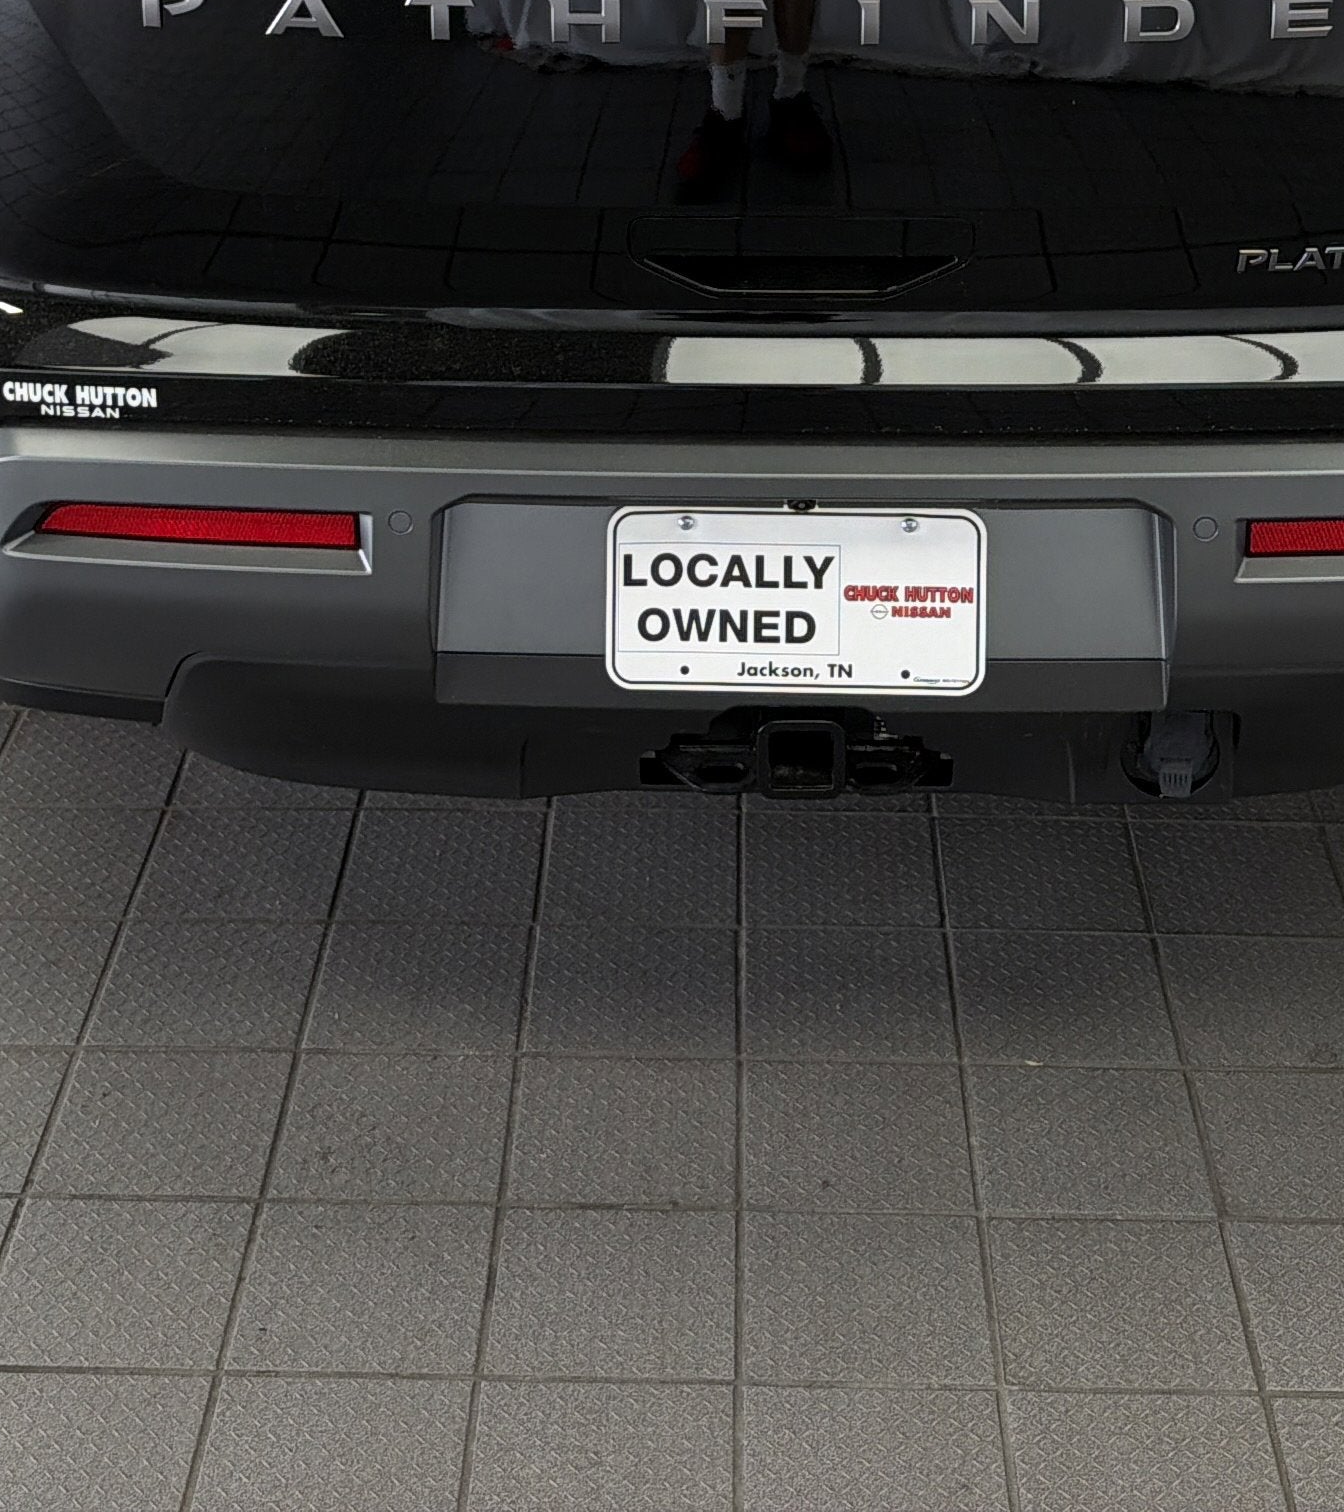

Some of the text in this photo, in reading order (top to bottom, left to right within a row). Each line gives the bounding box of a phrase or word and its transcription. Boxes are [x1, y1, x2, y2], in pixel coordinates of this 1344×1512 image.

[3, 381, 157, 407] CHUCK HUTTON
[41, 405, 119, 418] NISSAN
[623, 553, 834, 589] LOCALLY
[844, 585, 973, 603] CHUCK HUTTON
[892, 606, 951, 618] NISSAN
[638, 608, 816, 643] OWNED
[737, 661, 853, 679] Jackson, TN
